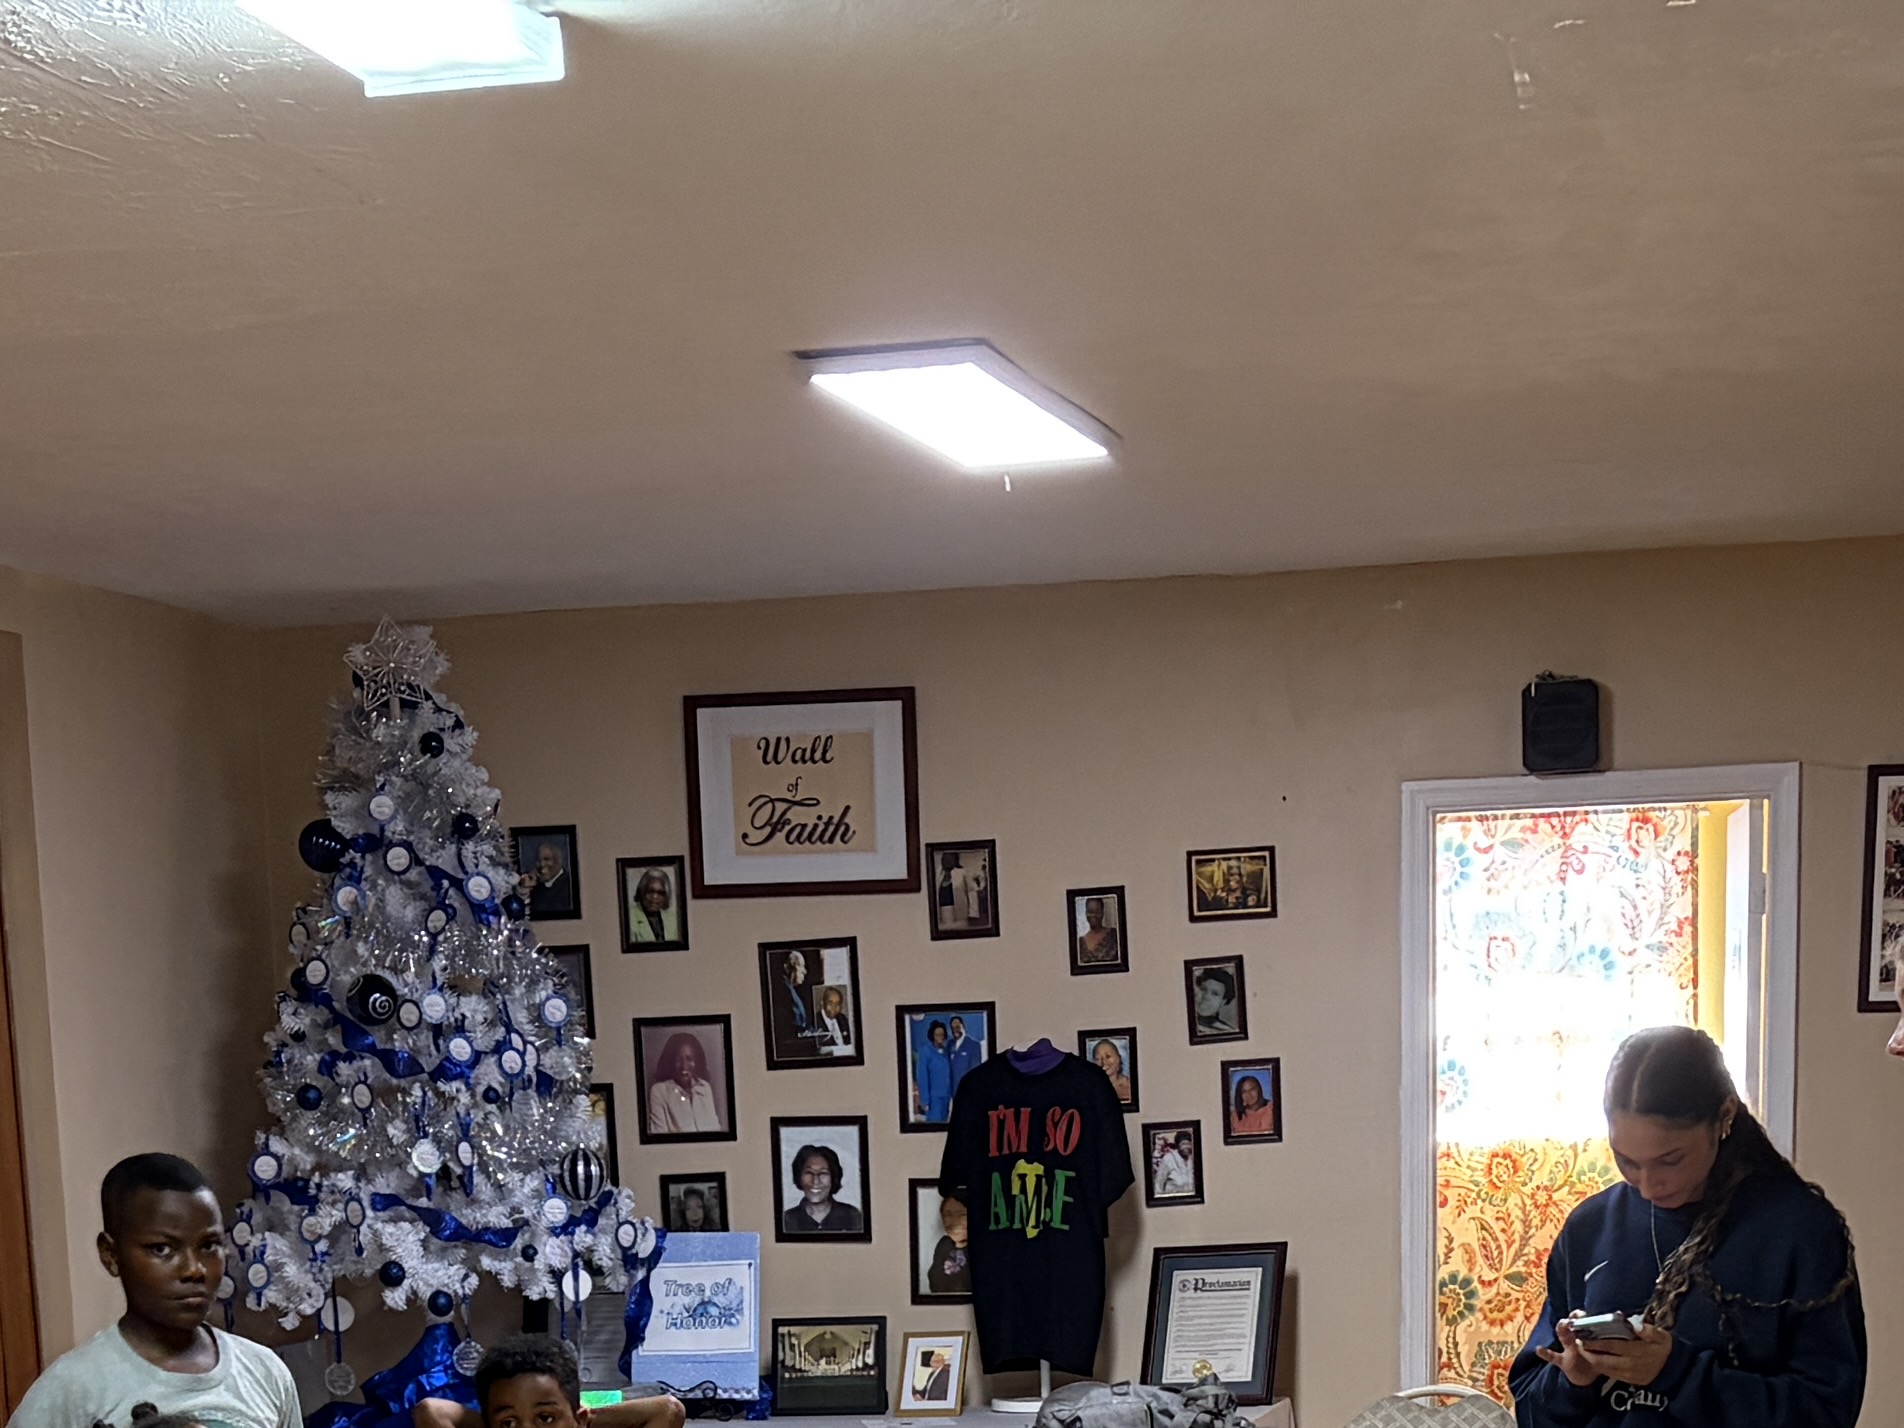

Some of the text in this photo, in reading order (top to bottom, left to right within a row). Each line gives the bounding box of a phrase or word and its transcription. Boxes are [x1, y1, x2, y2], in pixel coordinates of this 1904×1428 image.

[756, 734, 835, 765] Wall
[786, 776, 803, 798] of
[741, 794, 857, 847] Faith
[987, 1104, 1082, 1157] I'M SO
[663, 1277, 733, 1298] Tree of
[665, 1312, 727, 1331] Honor
